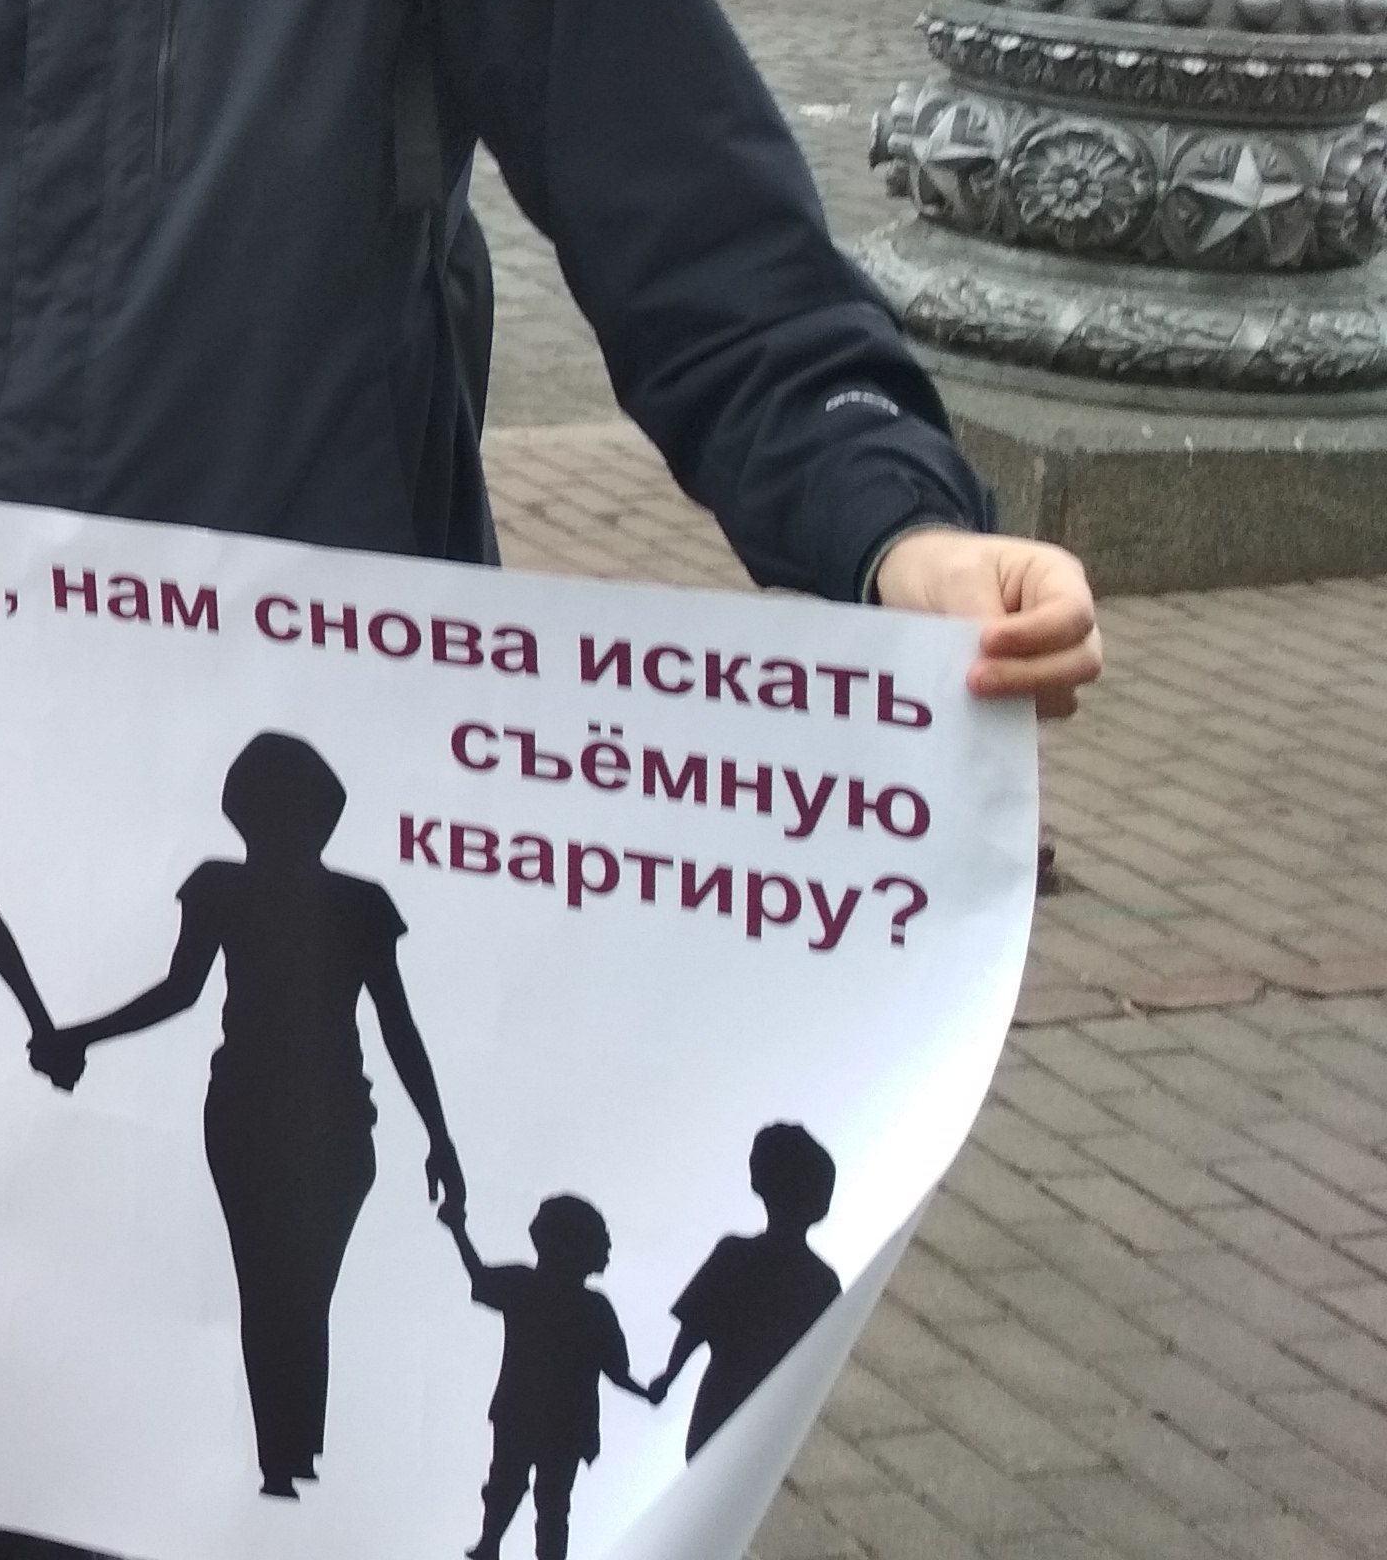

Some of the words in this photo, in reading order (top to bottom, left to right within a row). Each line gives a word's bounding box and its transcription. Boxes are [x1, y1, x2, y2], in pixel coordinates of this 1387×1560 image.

[51, 564, 220, 633] нам
[254, 593, 539, 676] снова
[579, 632, 933, 730] искать
[450, 721, 931, 840] съёмную
[399, 812, 929, 952] квартиру?
